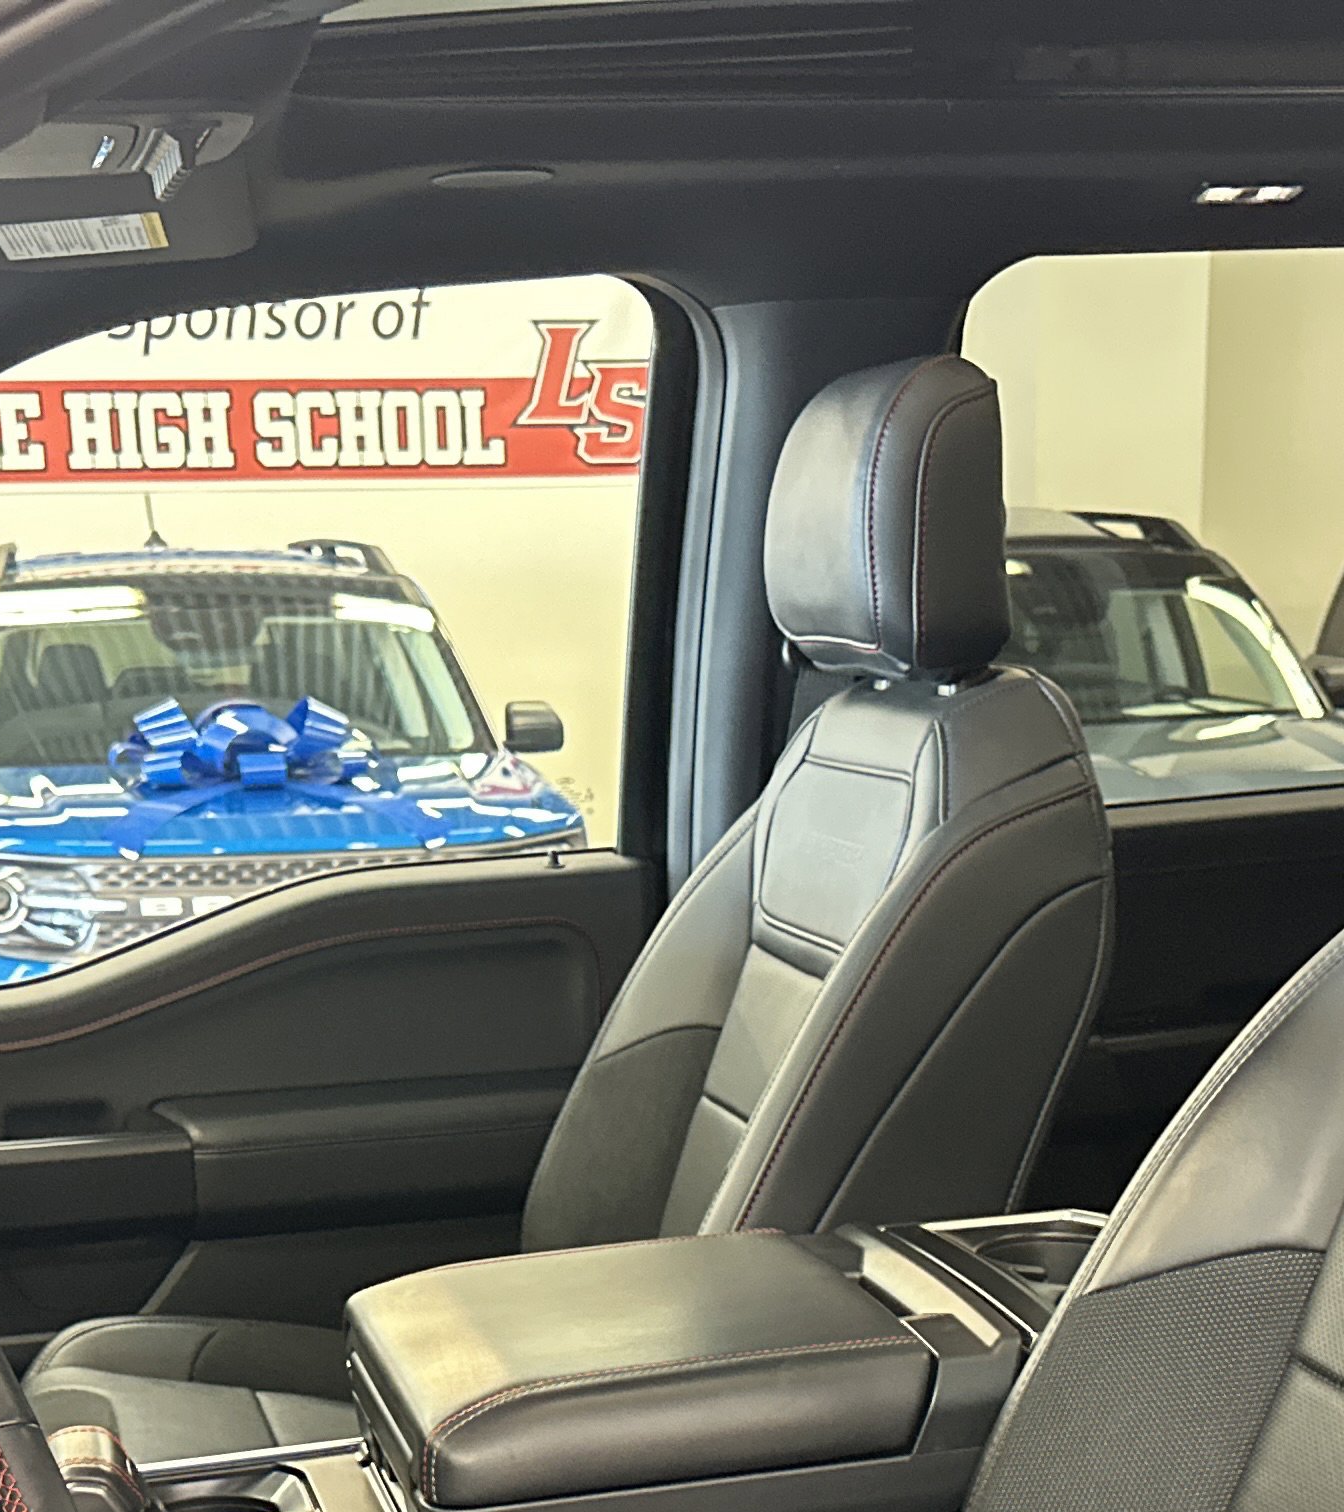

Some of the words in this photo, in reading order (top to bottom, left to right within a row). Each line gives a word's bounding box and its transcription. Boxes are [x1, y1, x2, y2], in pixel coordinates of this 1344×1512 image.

[371, 287, 431, 340] of
[61, 388, 237, 470] HIGH
[253, 386, 507, 469] SCHOOL
